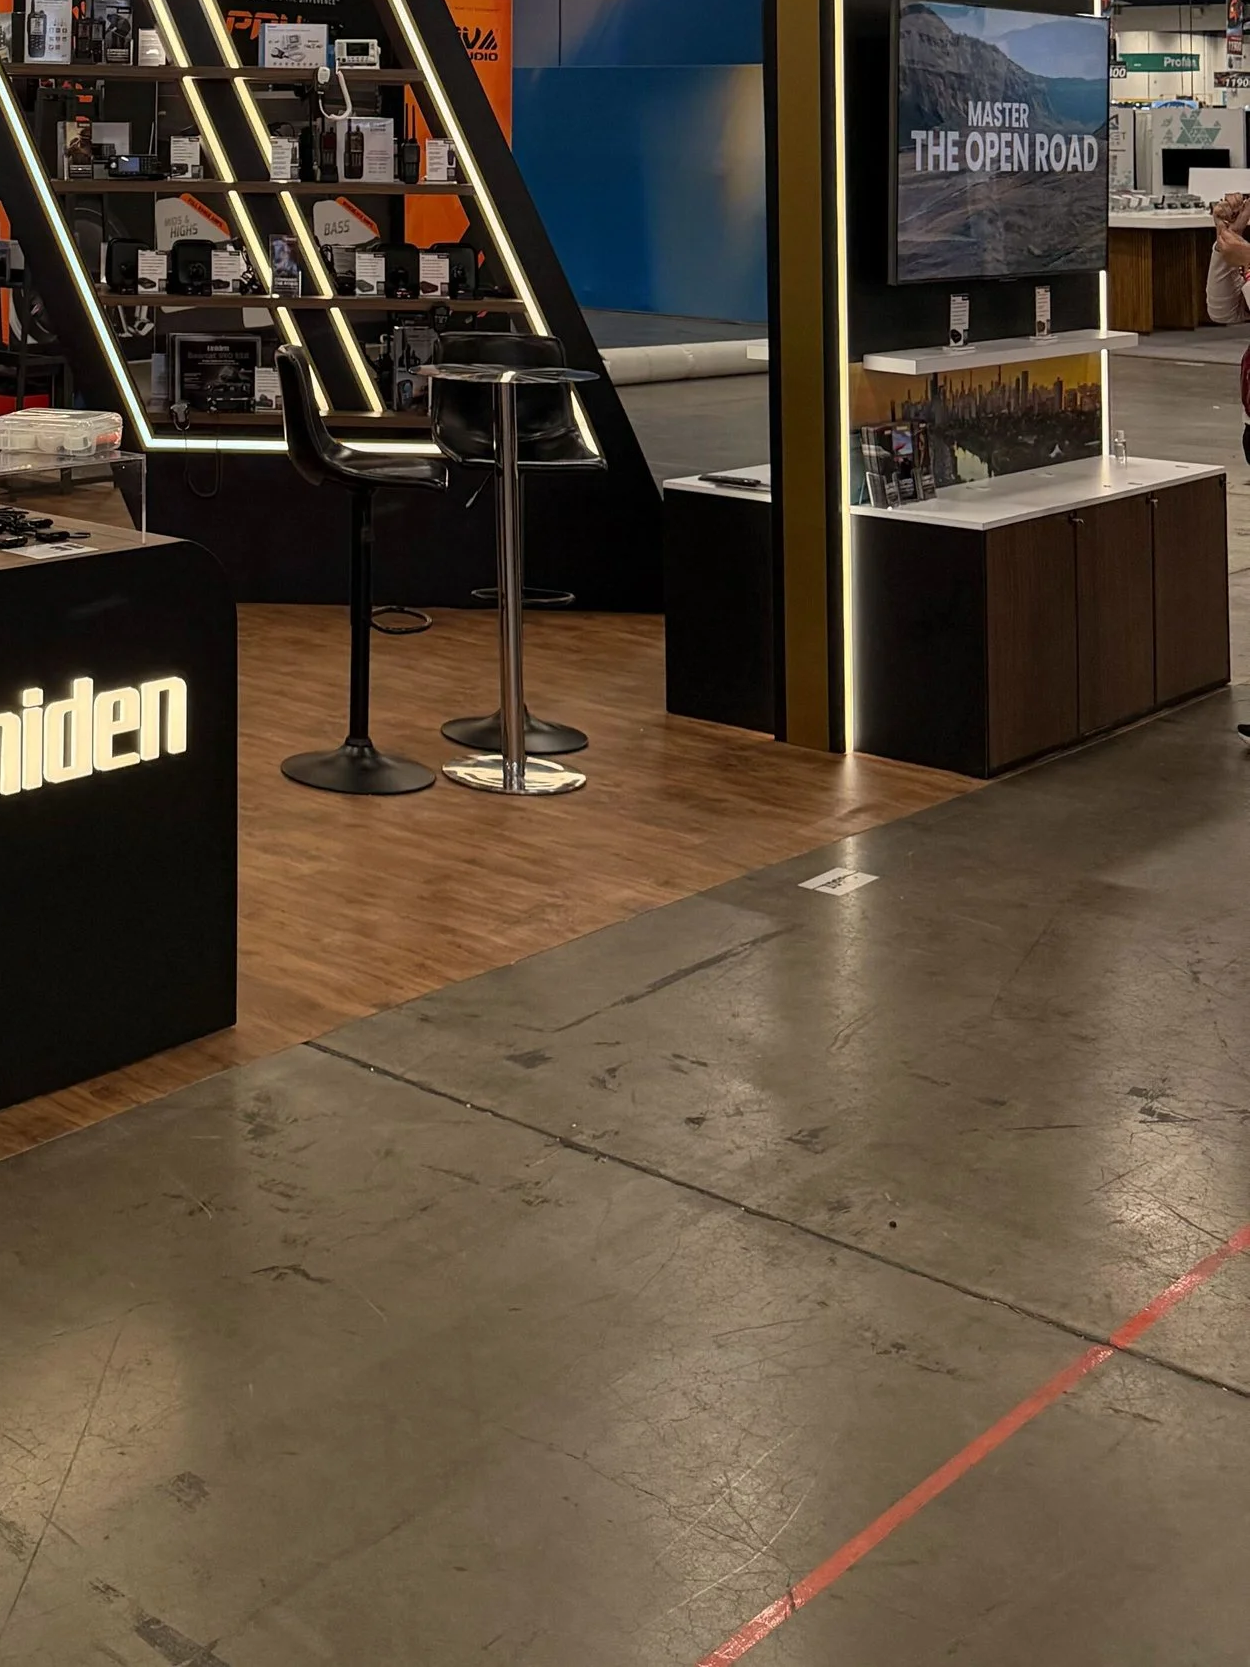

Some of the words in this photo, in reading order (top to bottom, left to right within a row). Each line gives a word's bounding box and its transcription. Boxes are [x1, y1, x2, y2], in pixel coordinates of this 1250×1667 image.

[968, 101, 1029, 129] MASTER
[911, 130, 959, 172] THE
[965, 131, 1029, 172] OPEN
[1035, 134, 1097, 172] ROAD
[170, 222, 198, 239] HIGHS
[323, 219, 350, 236] BASS
